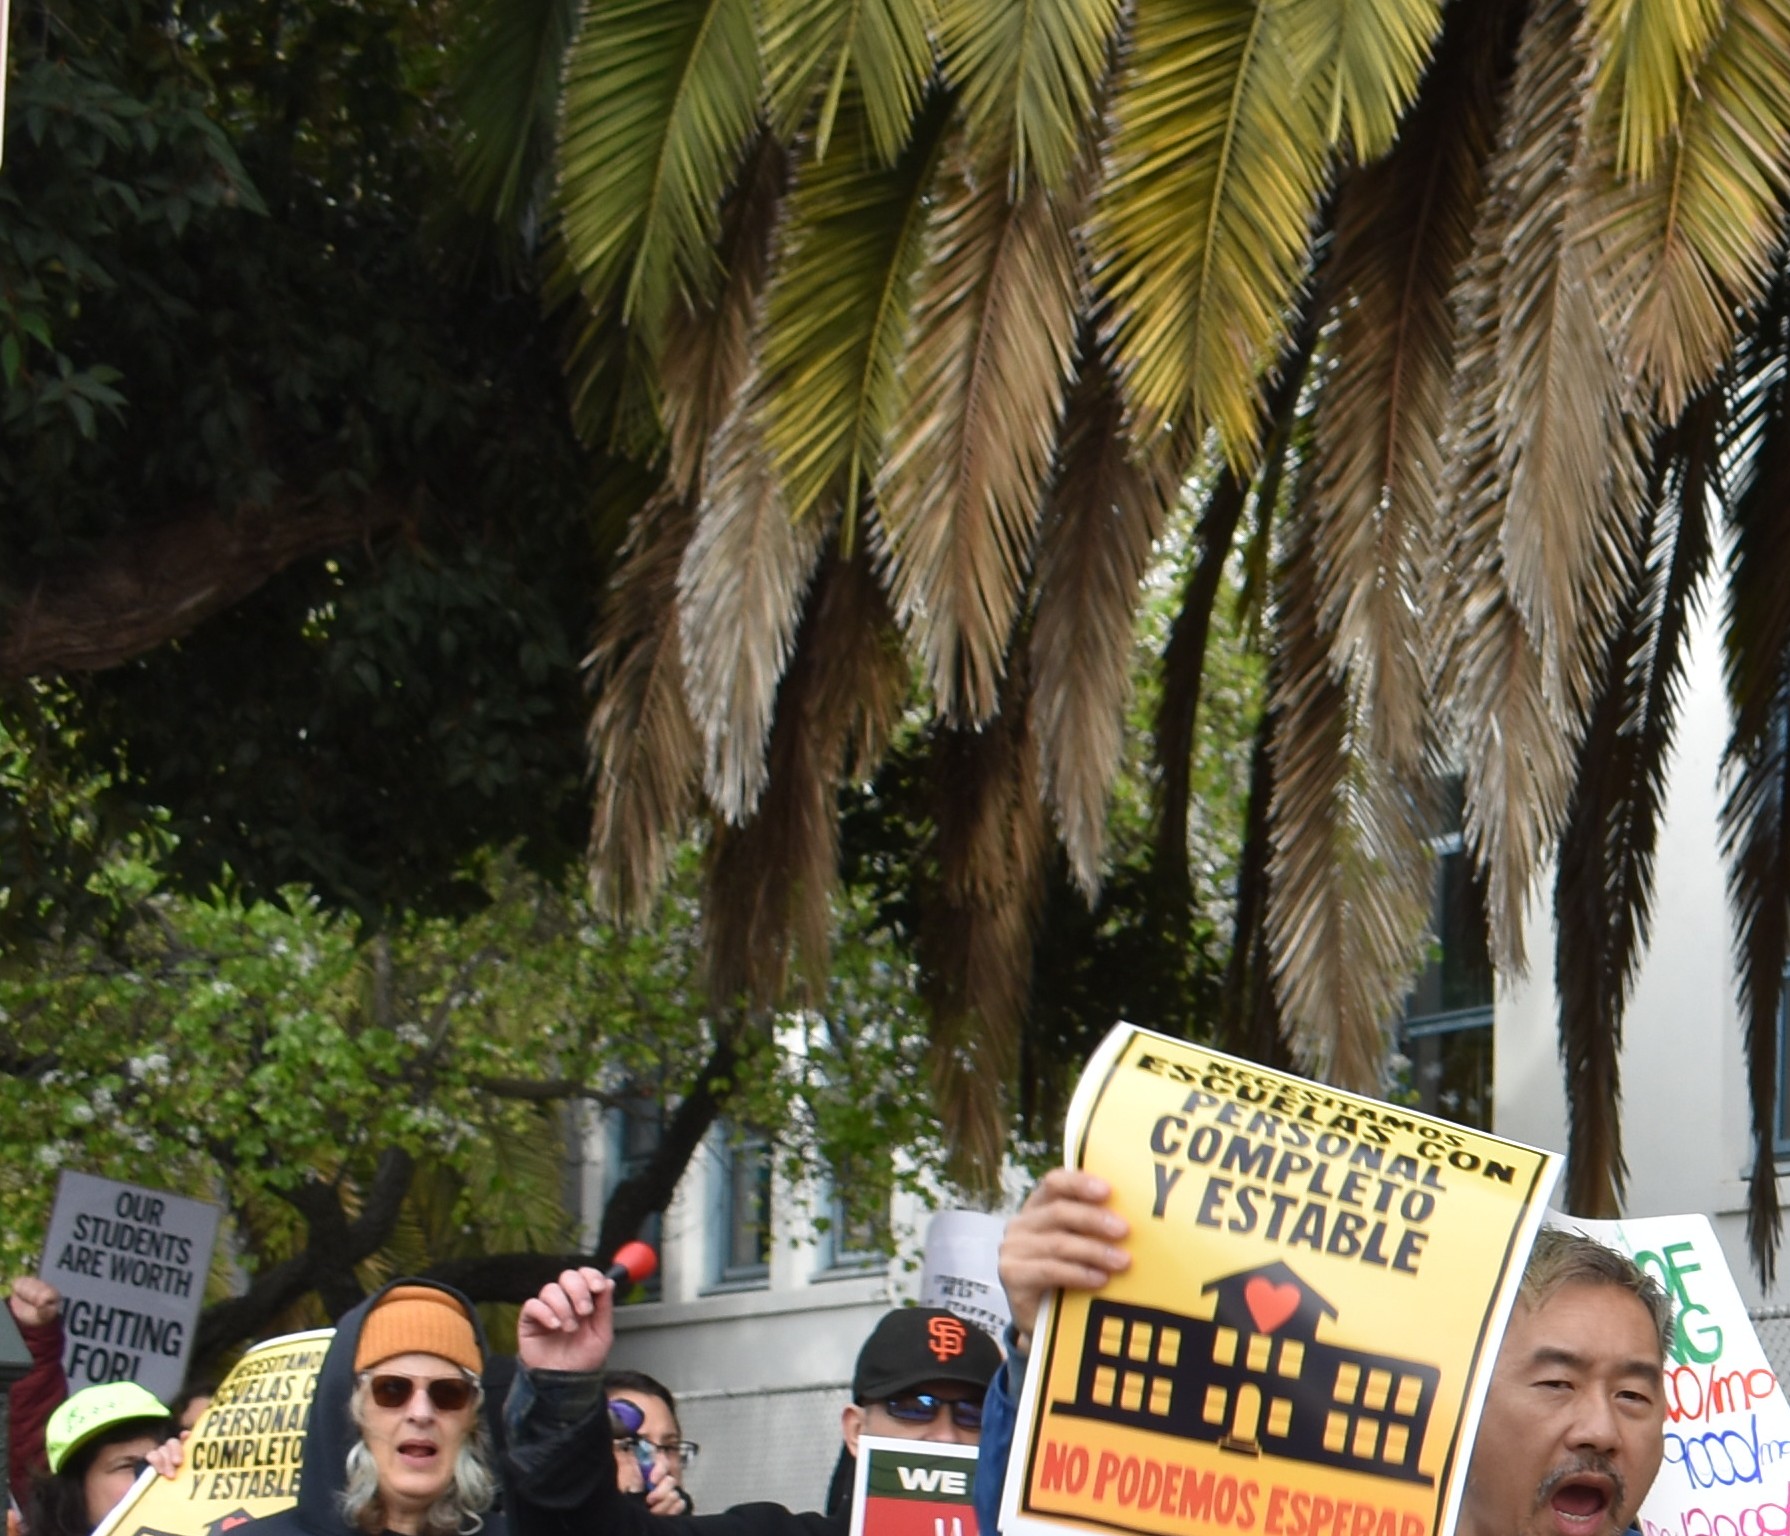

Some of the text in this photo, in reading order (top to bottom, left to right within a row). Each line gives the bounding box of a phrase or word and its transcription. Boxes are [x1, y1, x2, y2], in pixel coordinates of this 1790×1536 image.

[1136, 1053, 1518, 1186] ESCUELAS CON
[1207, 1060, 1467, 1149] NECESITAMOS
[1149, 1114, 1437, 1225] COMPLETO
[1181, 1090, 1449, 1193] PERSONAL
[117, 1191, 165, 1227] OUR
[1151, 1160, 1430, 1278] Y ESTABLE
[72, 1213, 193, 1266] STUDENTS
[56, 1244, 194, 1298] ARE WORTH
[61, 1297, 184, 1357] IGHTING
[191, 1435, 304, 1471] COMPLETO
[897, 1466, 967, 1495] WE
[188, 1468, 301, 1500] Y ESTABLE
[1039, 1440, 1090, 1494] NO
[1092, 1451, 1260, 1532] PODEMOS
